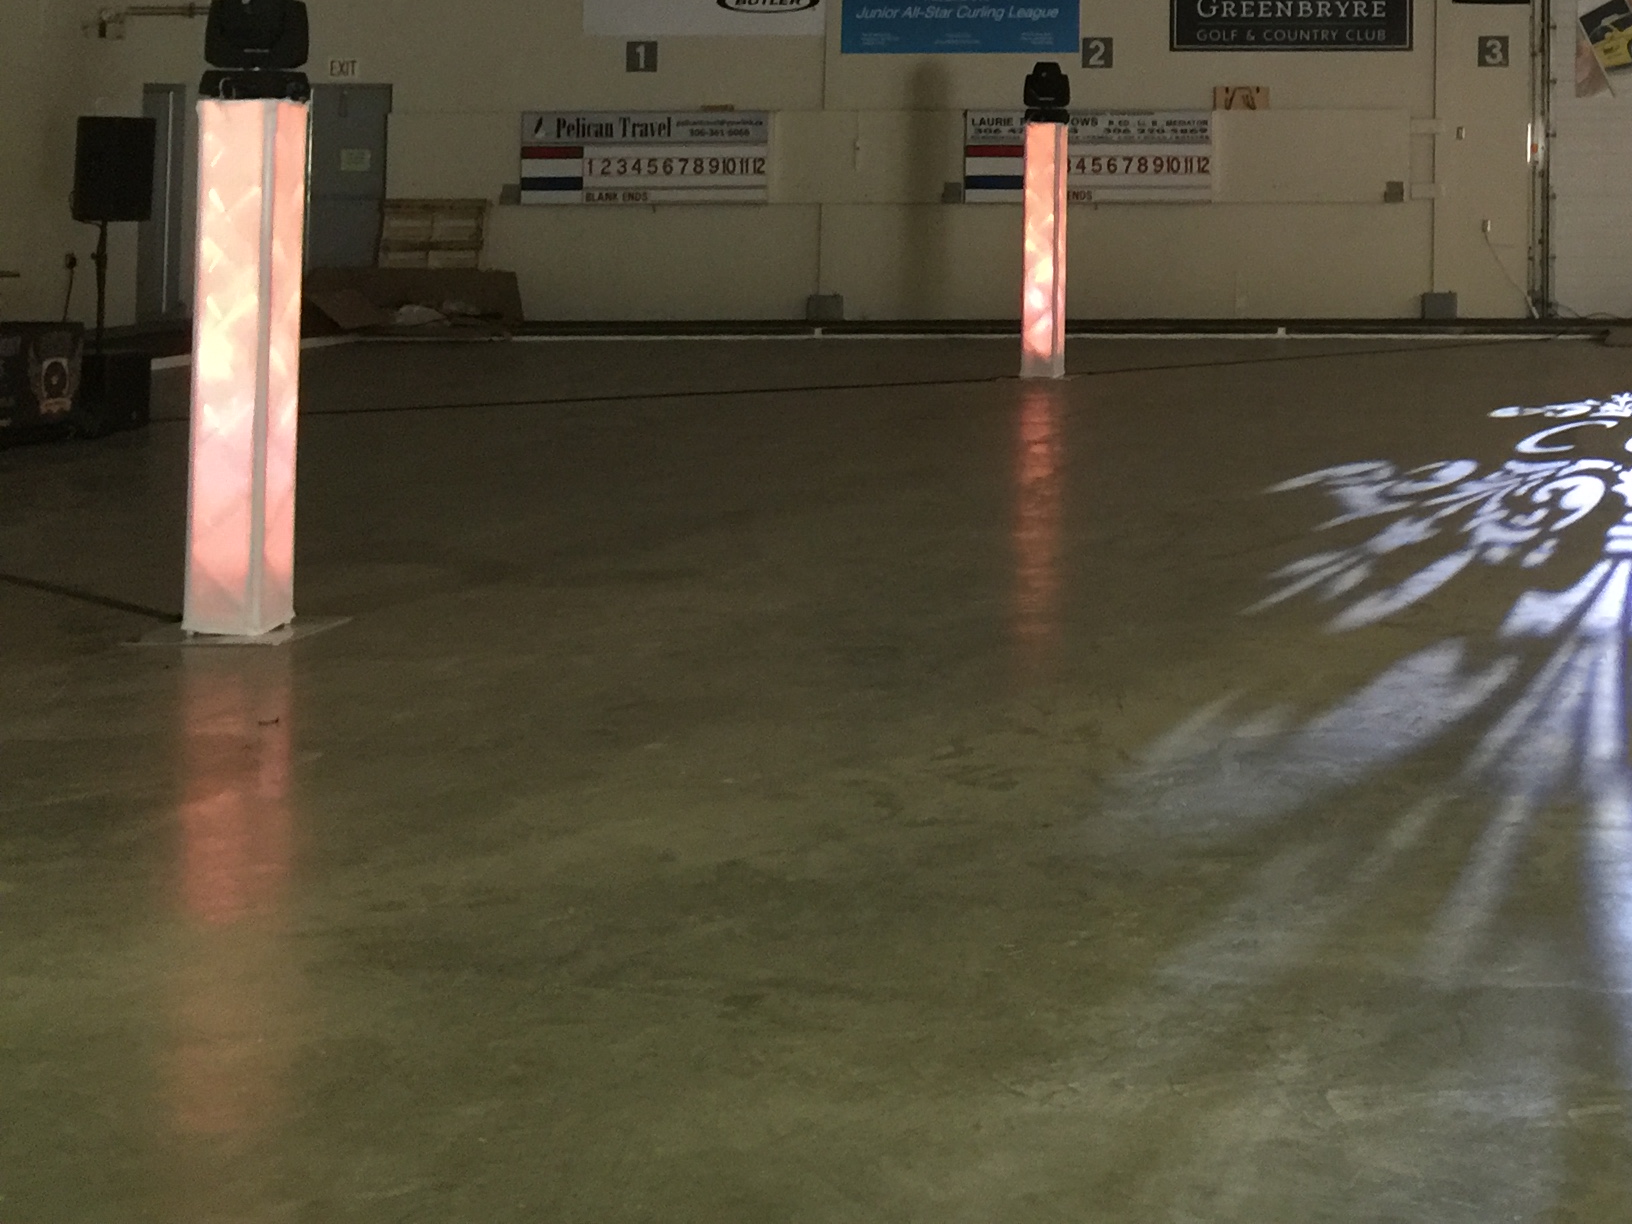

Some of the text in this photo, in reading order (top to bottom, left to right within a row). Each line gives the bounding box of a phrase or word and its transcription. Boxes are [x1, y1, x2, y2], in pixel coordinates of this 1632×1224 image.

[856, 5, 1059, 23] Junior All-Star Curling League
[1196, 29, 1386, 41] GOLF & COUNTRY CLUB
[635, 44, 646, 70] 1
[1088, 40, 1105, 66] 2
[1485, 38, 1503, 64] 3
[330, 60, 357, 76] EXIT
[555, 117, 614, 139] Pelican
[618, 116, 672, 138] Travel
[971, 117, 1014, 127] LAURIE
[587, 158, 766, 175] 1 2 3 4 5 6 7 8 9 10 11 12
[1075, 157, 1210, 174] 4 5 6 7 8 9 10 11 12
[585, 192, 648, 201] BLANK ENDS
